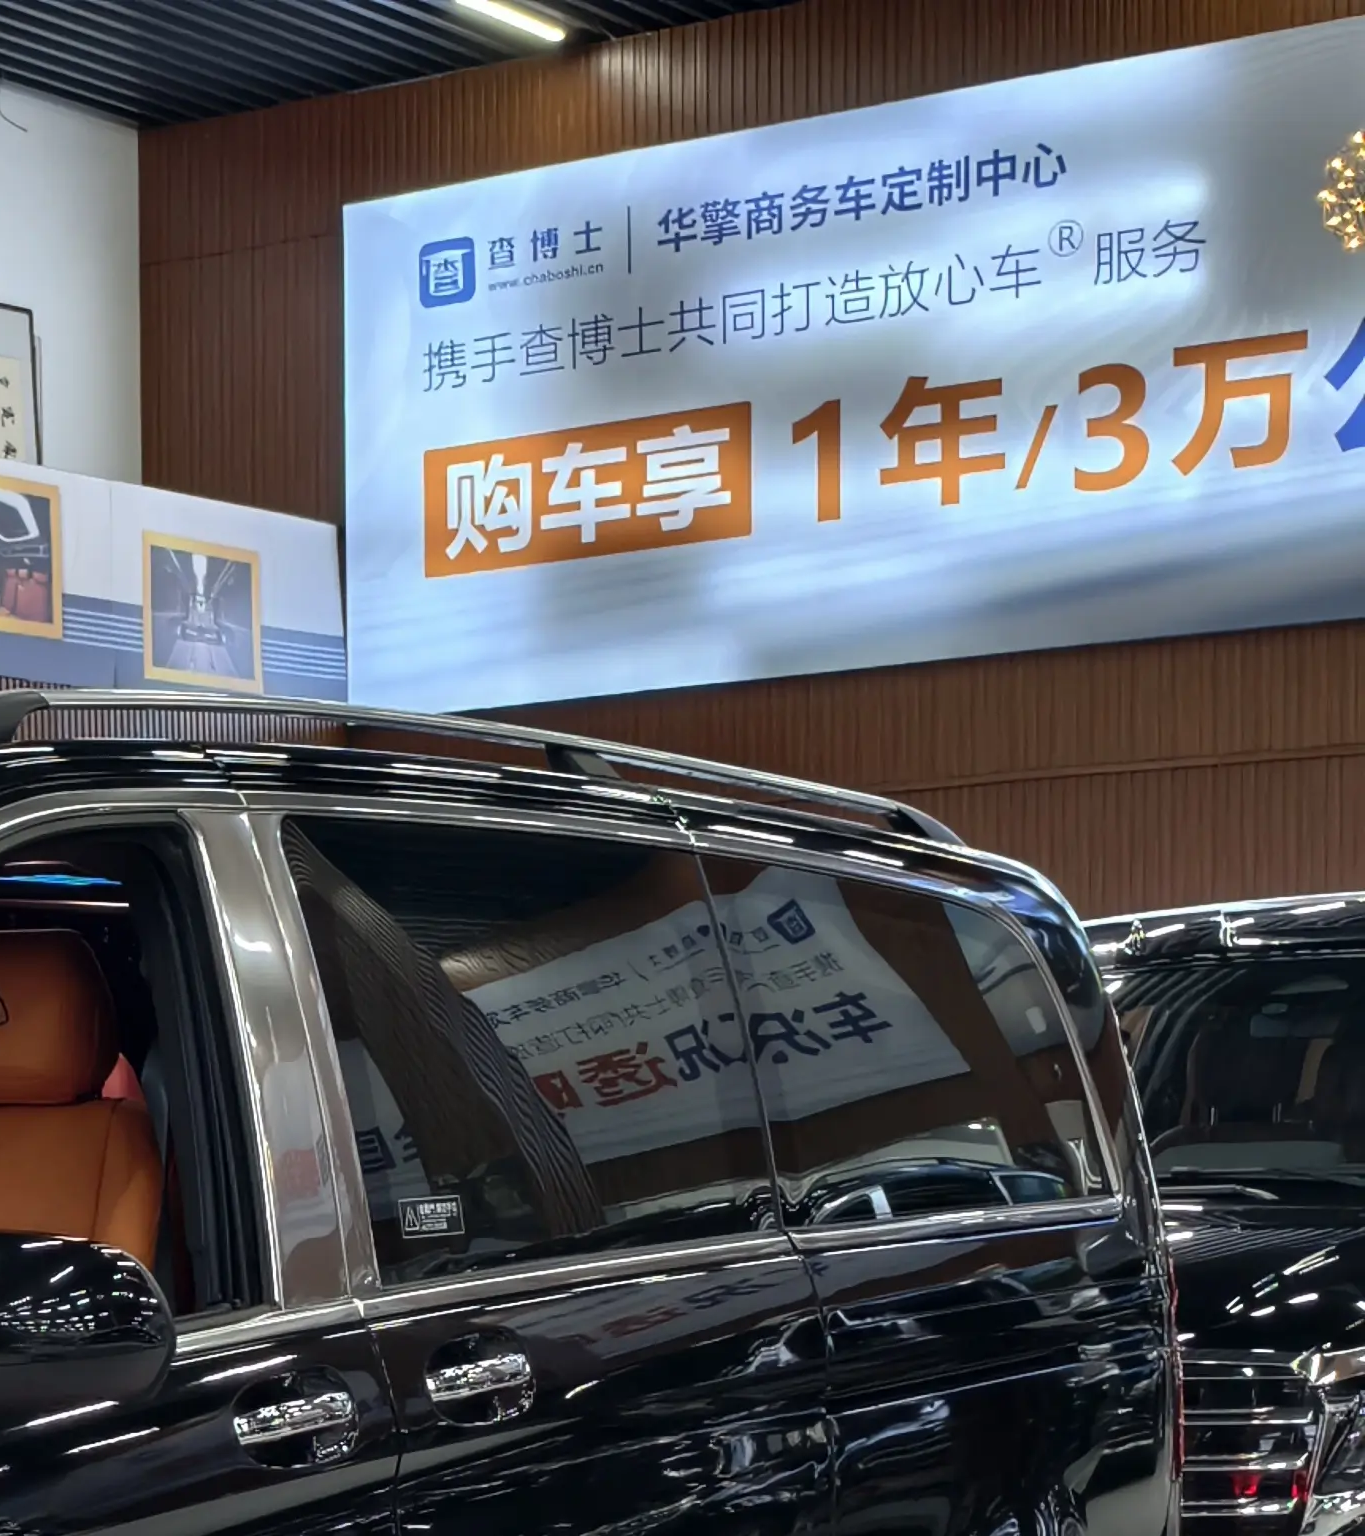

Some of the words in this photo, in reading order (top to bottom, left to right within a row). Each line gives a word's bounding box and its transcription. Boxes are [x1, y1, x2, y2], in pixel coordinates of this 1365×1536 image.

[487, 220, 603, 271] 查博士
[655, 140, 1068, 254] 华擎商务车定制中心
[487, 261, 605, 292] www.chaboshi.cn
[442, 423, 733, 560] 购车享
